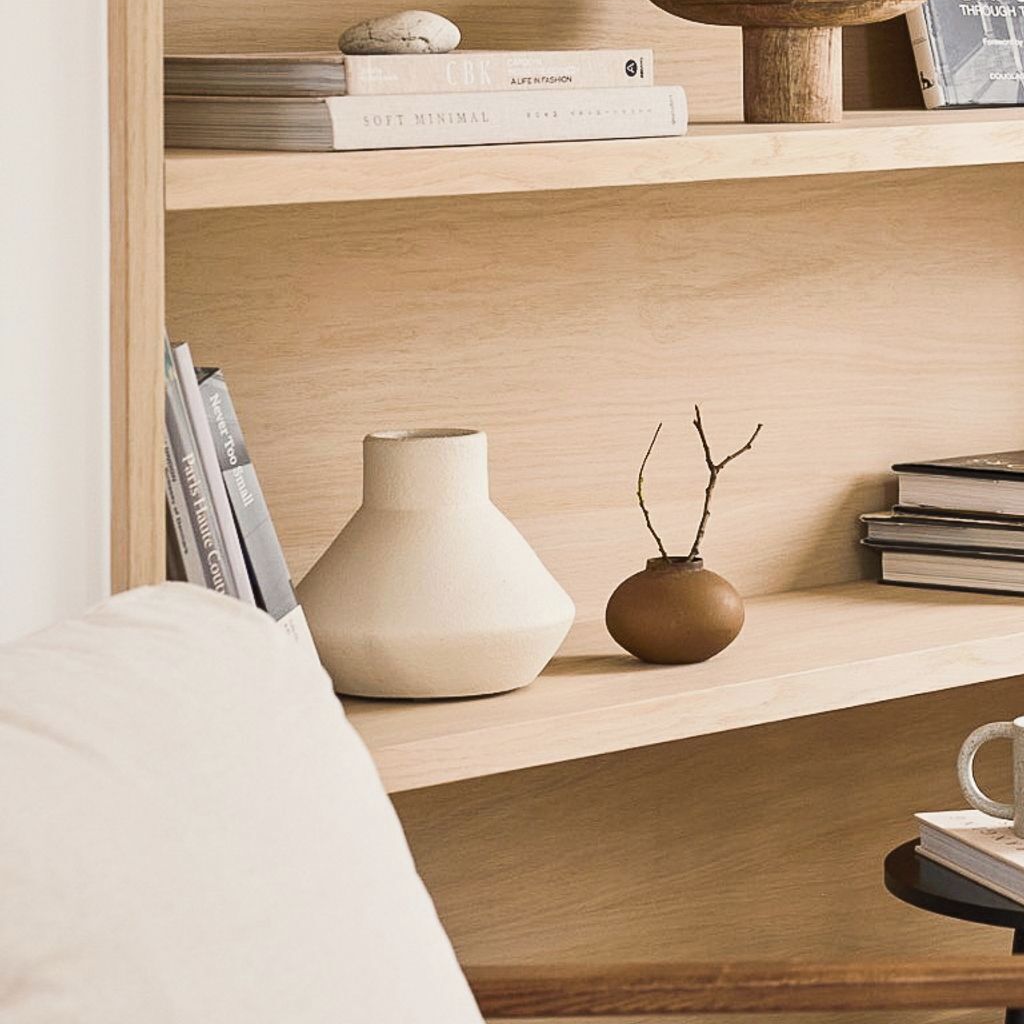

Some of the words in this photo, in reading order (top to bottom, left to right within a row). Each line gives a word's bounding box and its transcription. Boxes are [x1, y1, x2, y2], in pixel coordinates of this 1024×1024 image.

[959, 4, 1017, 17] THROUGH
[541, 75, 573, 84] FASHION
[363, 113, 405, 127] SOFT
[414, 110, 491, 126] MINIMAL
[209, 392, 229, 435] Never
[224, 435, 238, 465] Too
[232, 465, 254, 508] Small
[182, 452, 201, 497] Paris
[193, 496, 214, 549] Haute
